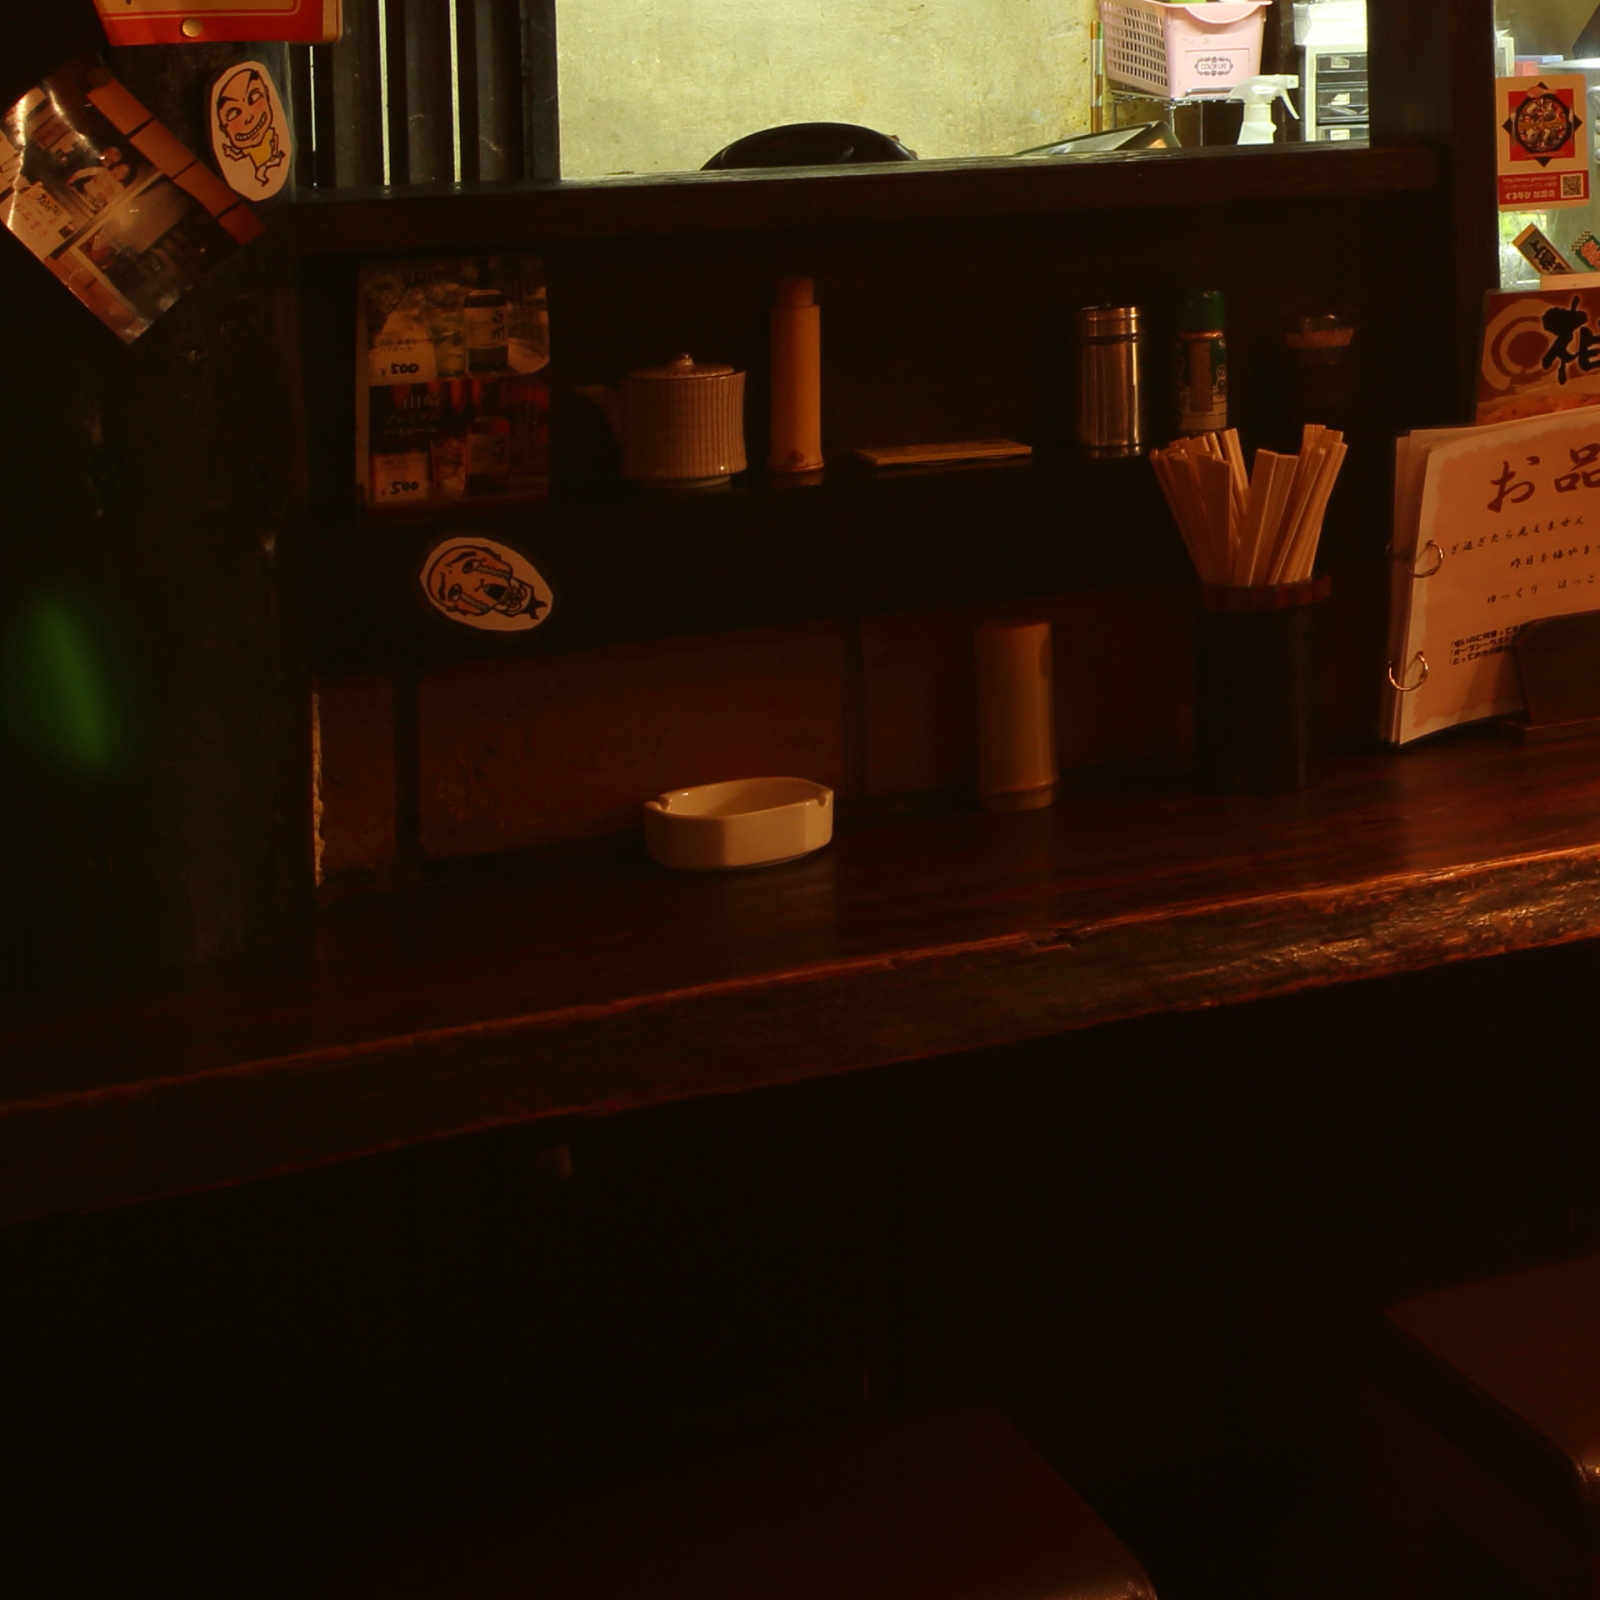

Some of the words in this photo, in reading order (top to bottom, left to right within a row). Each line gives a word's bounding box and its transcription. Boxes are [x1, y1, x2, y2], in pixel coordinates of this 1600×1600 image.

[1505, 190, 1531, 200] ぐるなび
[1533, 189, 1557, 199] 加盟店
[390, 362, 421, 376] 500
[389, 480, 420, 496] 500
[1487, 582, 1541, 605] ゆっくり
